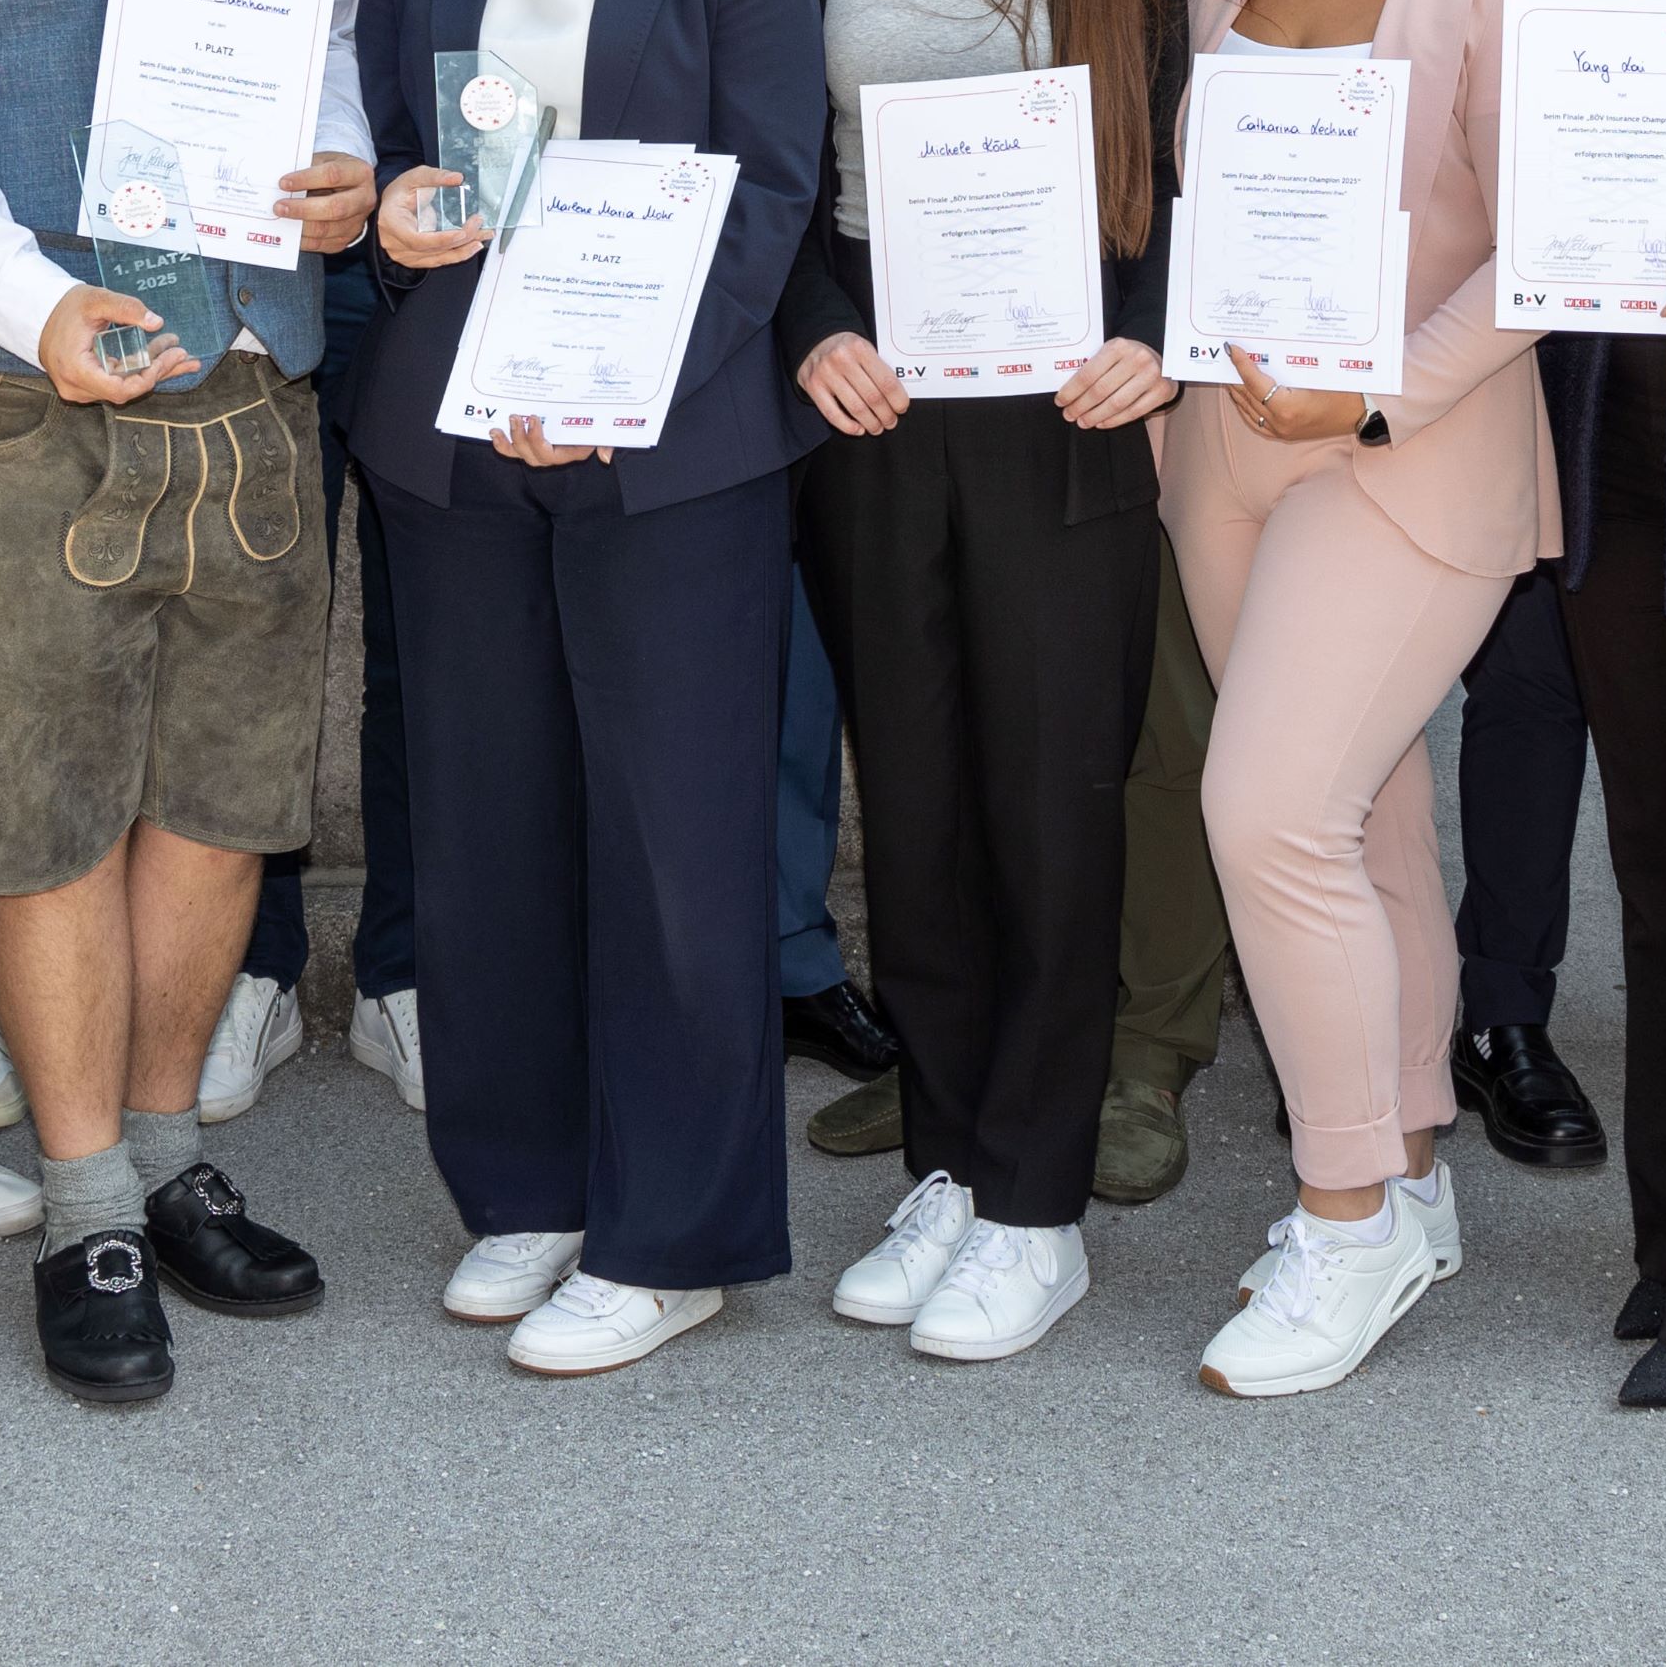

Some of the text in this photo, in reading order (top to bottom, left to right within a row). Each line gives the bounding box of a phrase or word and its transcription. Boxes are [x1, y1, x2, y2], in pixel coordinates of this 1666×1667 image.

[194, 42, 234, 56] 1. PLATZ
[1572, 49, 1610, 83] Yang
[1236, 114, 1301, 134] Catharina
[919, 140, 972, 159] Michele
[1574, 151, 1612, 159] erfolgreich
[1308, 176, 1339, 184] Champion
[968, 192, 1000, 200] Insurance
[1002, 188, 1034, 198] Champion
[597, 199, 638, 218] Maria
[642, 204, 675, 221] Mohr
[941, 229, 978, 238] erfolgreich
[114, 252, 192, 275] 1. PLATZ
[580, 253, 621, 263] 3. PLATZ
[136, 273, 177, 291] 2025
[612, 281, 643, 289] Champion
